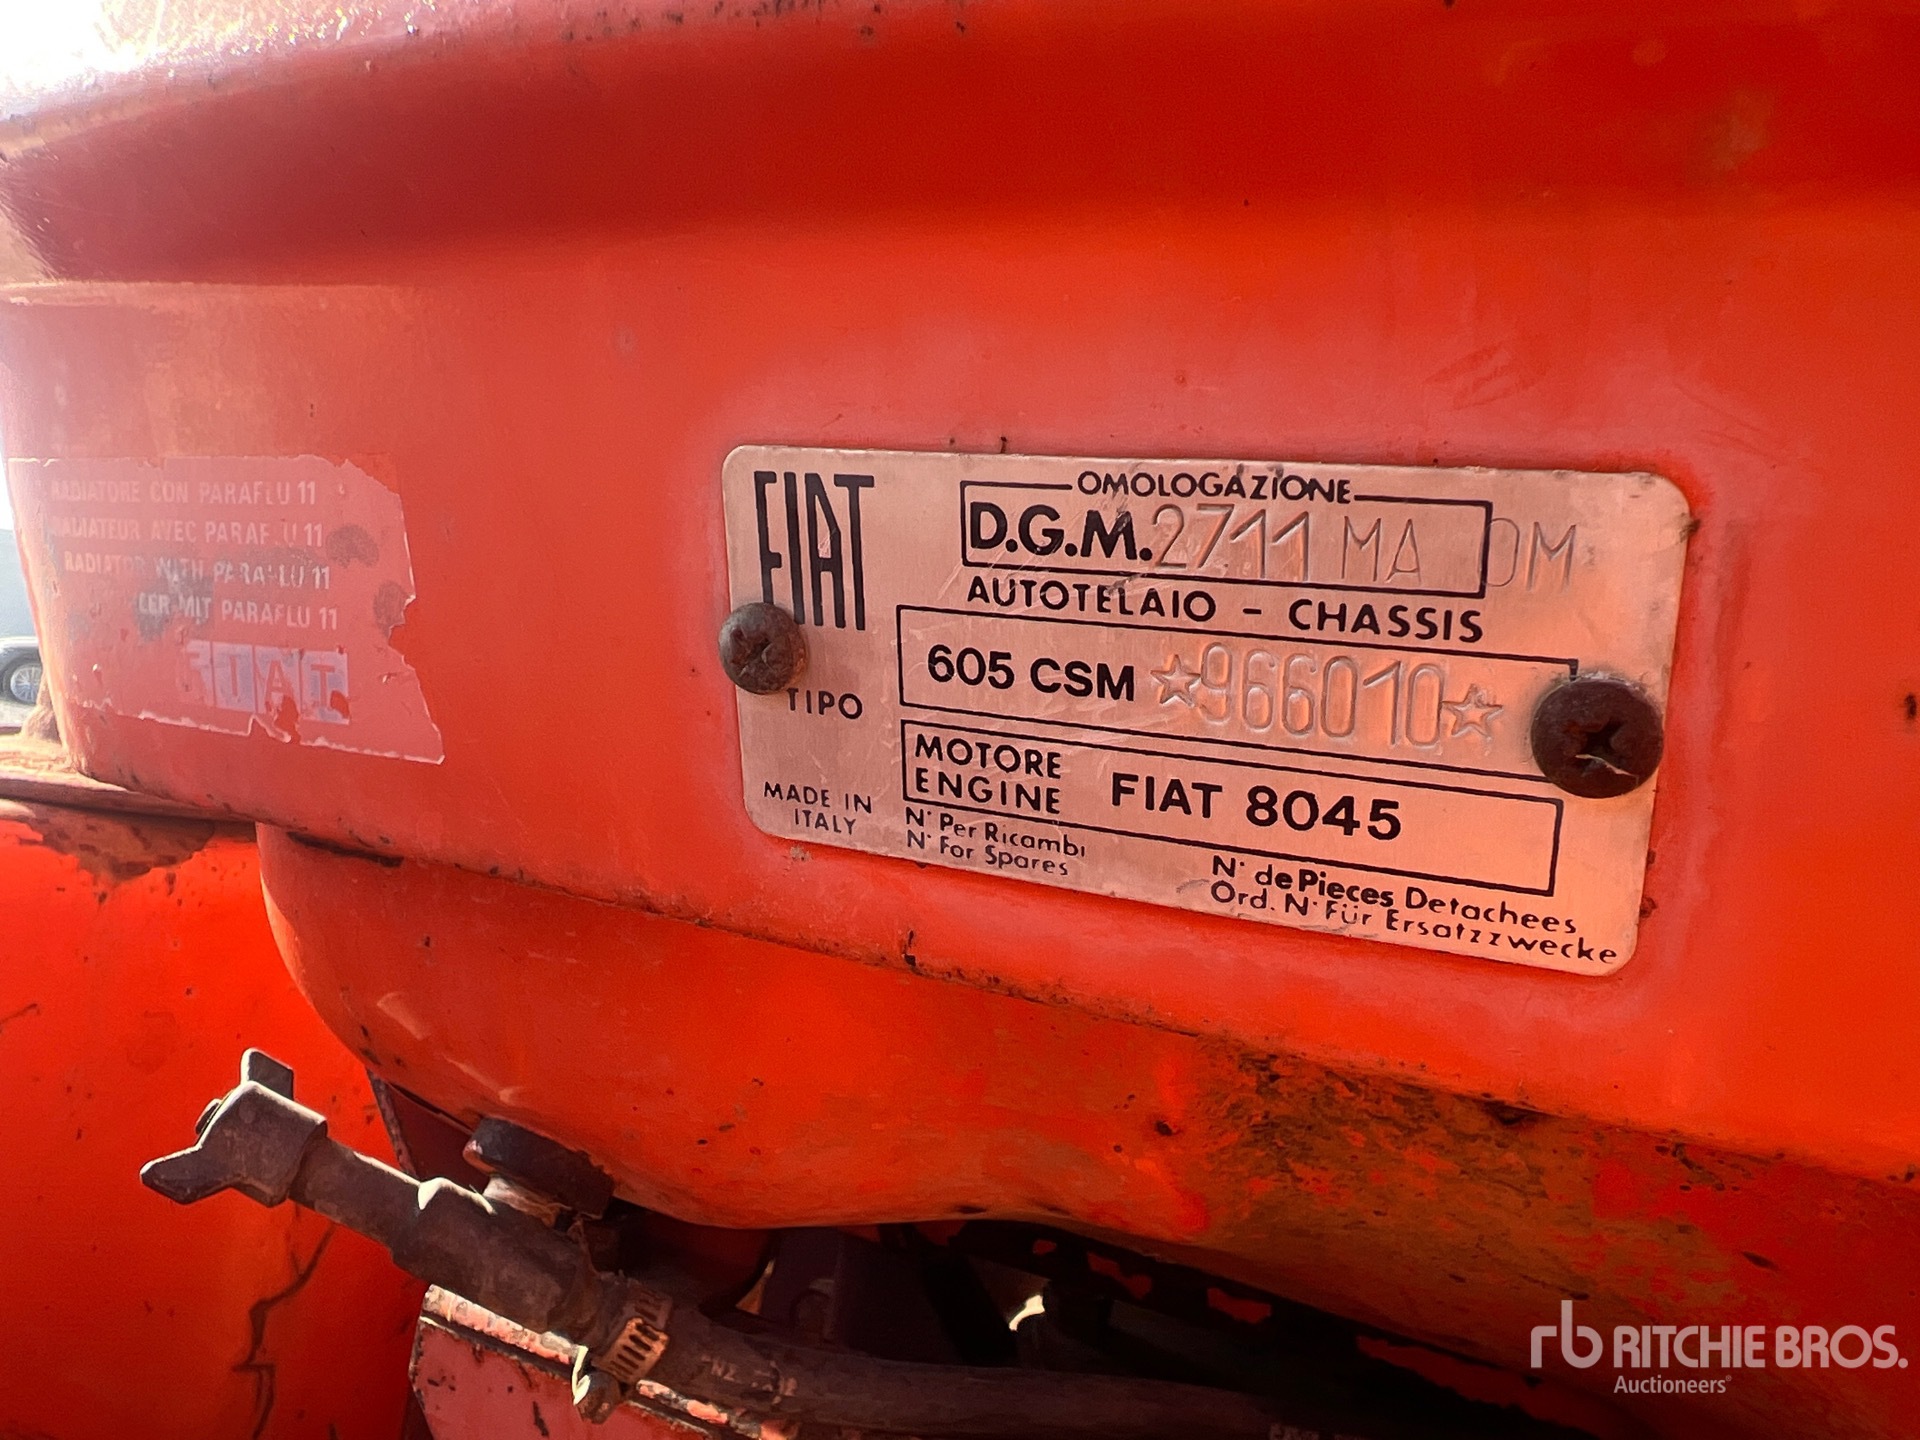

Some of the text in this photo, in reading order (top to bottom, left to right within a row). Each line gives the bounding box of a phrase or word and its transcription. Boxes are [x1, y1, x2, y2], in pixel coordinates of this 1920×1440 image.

[150, 481, 189, 504] CON
[199, 480, 291, 505] PARAFLU
[297, 480, 316, 505] 11
[1077, 470, 1352, 504] OMOLOGAZIONE
[150, 519, 197, 543] AVEC
[303, 522, 323, 547] 11
[754, 471, 875, 631] FIAT
[969, 501, 1153, 561] D.G.M.
[1151, 502, 1311, 582] 2711
[1342, 516, 1420, 583] MA
[154, 555, 204, 581] WITH
[311, 565, 330, 590] 11
[221, 600, 311, 628] PARAFLU
[319, 606, 338, 630] 11
[967, 576, 1217, 622] AUTOTELAIO
[1288, 599, 1483, 643] CHASSIS
[787, 687, 863, 720] TIPO
[927, 643, 1444, 748] 605 CSM 966010
[915, 733, 1062, 779] MOTORE
[763, 781, 872, 814] MADE IN
[915, 767, 1061, 815] ENGINE
[1112, 772, 1401, 841] FIAT 8045
[794, 808, 856, 835] ITALY
[939, 813, 978, 839] Per
[984, 821, 1086, 858] Ricambi
[940, 835, 973, 859] For
[985, 845, 1070, 876] Spares
[1254, 863, 1293, 889] de
[1297, 868, 1394, 908] Pieces
[1405, 886, 1578, 935] Detachees
[1210, 879, 1276, 912] Ord.
[1325, 900, 1372, 926] Für
[1386, 908, 1619, 965] Ersatzzwecke
